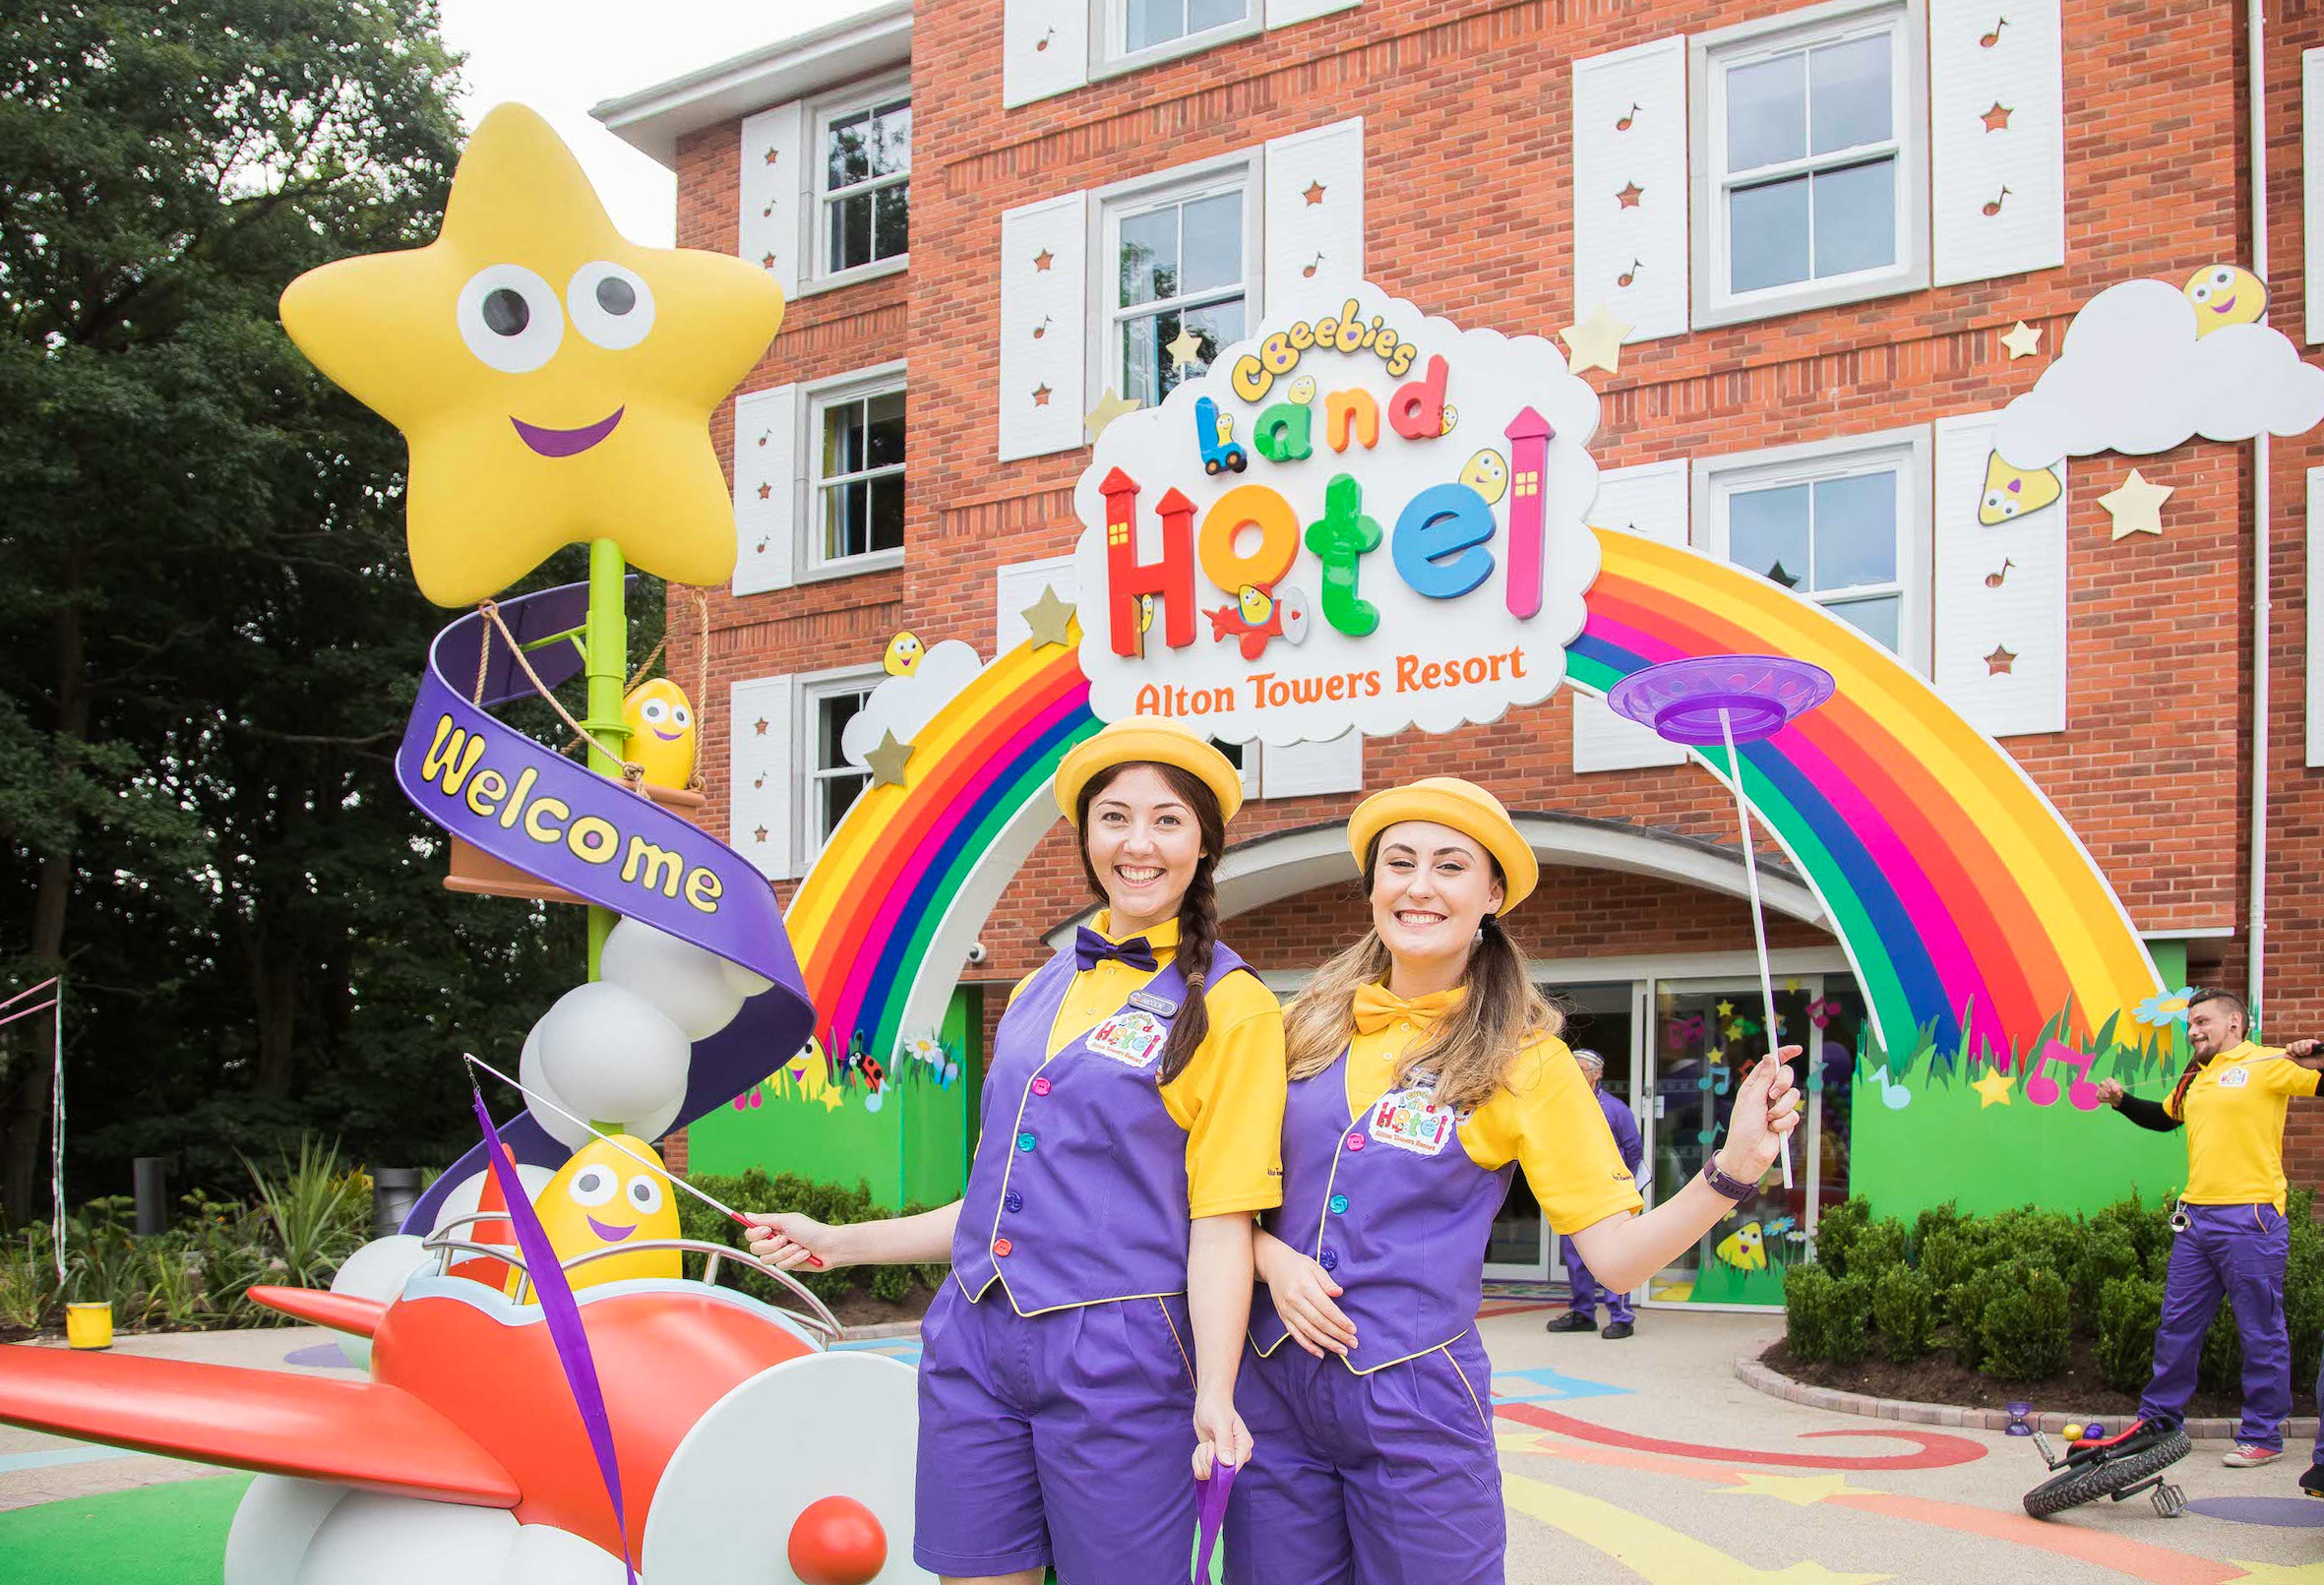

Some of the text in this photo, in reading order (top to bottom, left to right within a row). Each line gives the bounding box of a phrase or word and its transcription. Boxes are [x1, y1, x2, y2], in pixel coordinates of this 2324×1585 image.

[1232, 298, 1417, 403] CBeebies
[1195, 354, 1449, 475] Land
[1099, 405, 1557, 658] Hotel
[1135, 645, 1527, 717] Alton Towers Resort
[421, 713, 723, 914] Welcome
[1095, 1021, 1161, 1059] Hotel
[1376, 1102, 1448, 1144] Hotel
